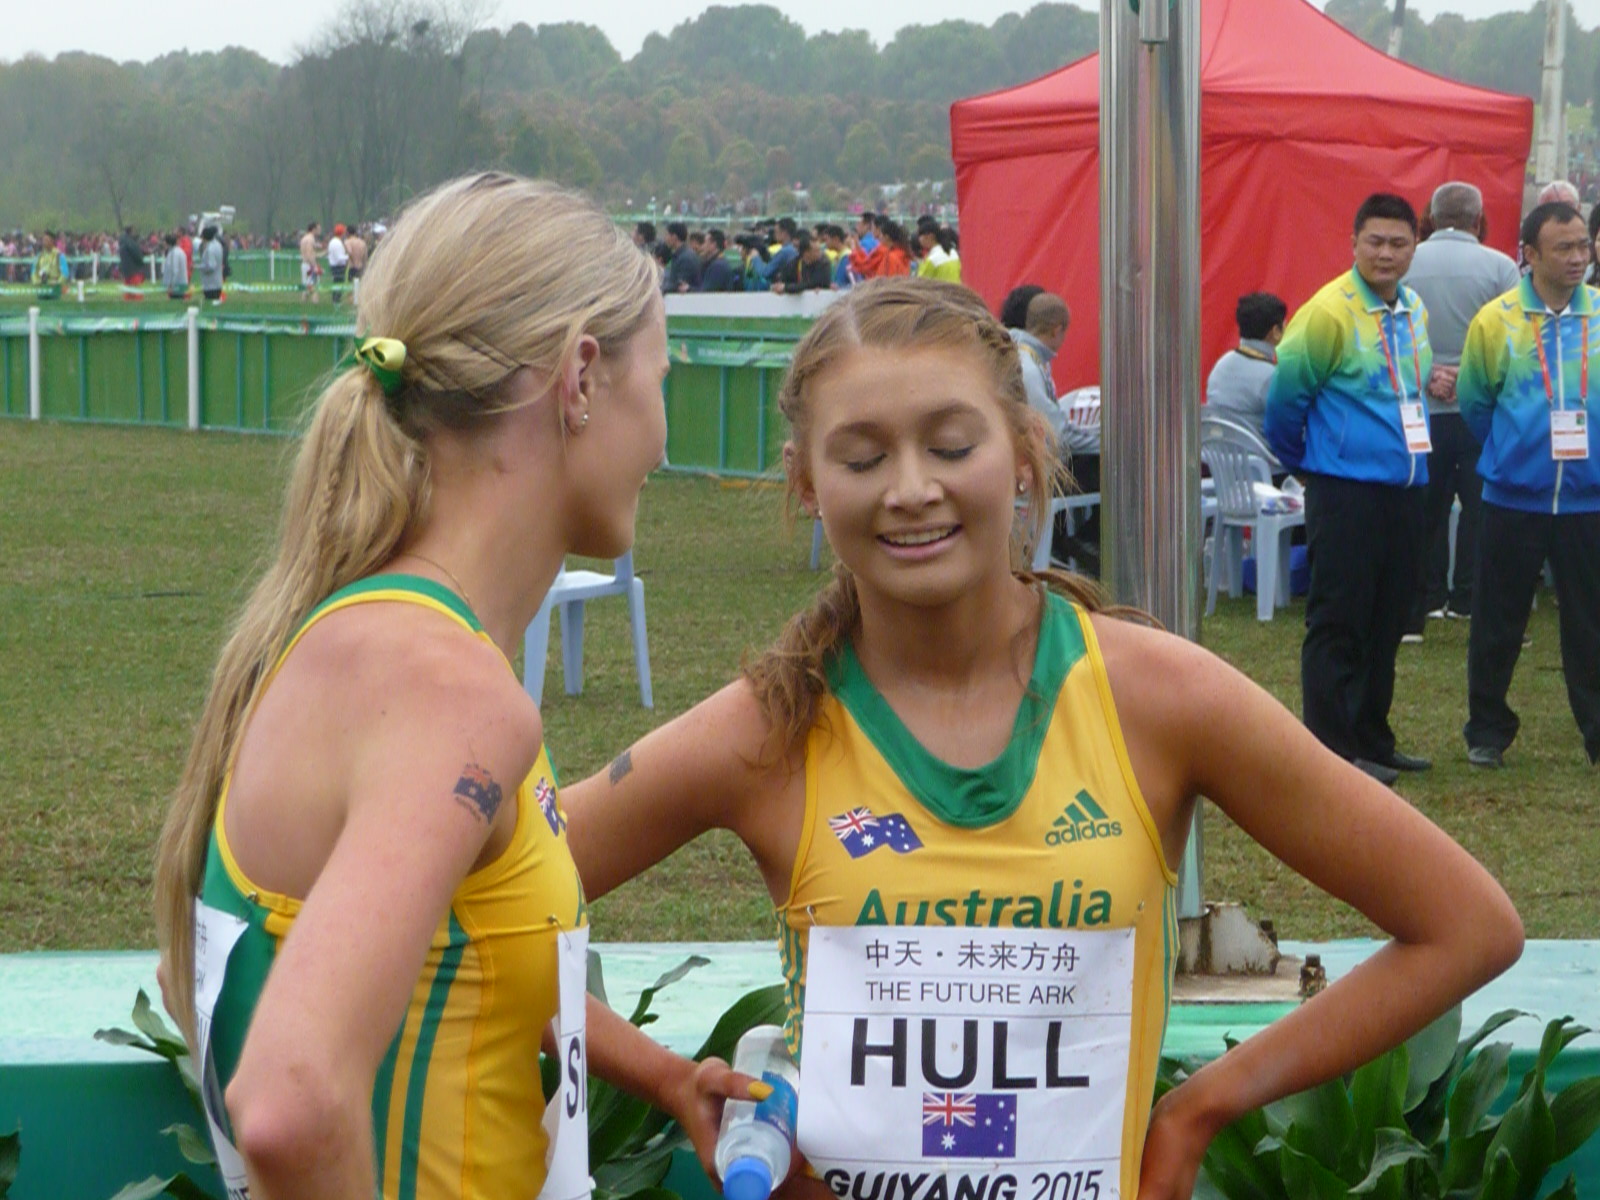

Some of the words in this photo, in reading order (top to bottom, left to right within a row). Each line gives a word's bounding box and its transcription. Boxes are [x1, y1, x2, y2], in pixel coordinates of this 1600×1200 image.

[1045, 820, 1123, 846] adidas
[855, 879, 1113, 927] Australia
[865, 981, 911, 1002] THE
[920, 982, 1021, 1004] FUTURE
[1029, 983, 1077, 1005] ARK
[850, 1017, 1090, 1090] HULL
[823, 1168, 1018, 1200] GUIYANG
[1031, 1169, 1104, 1200] 2015
